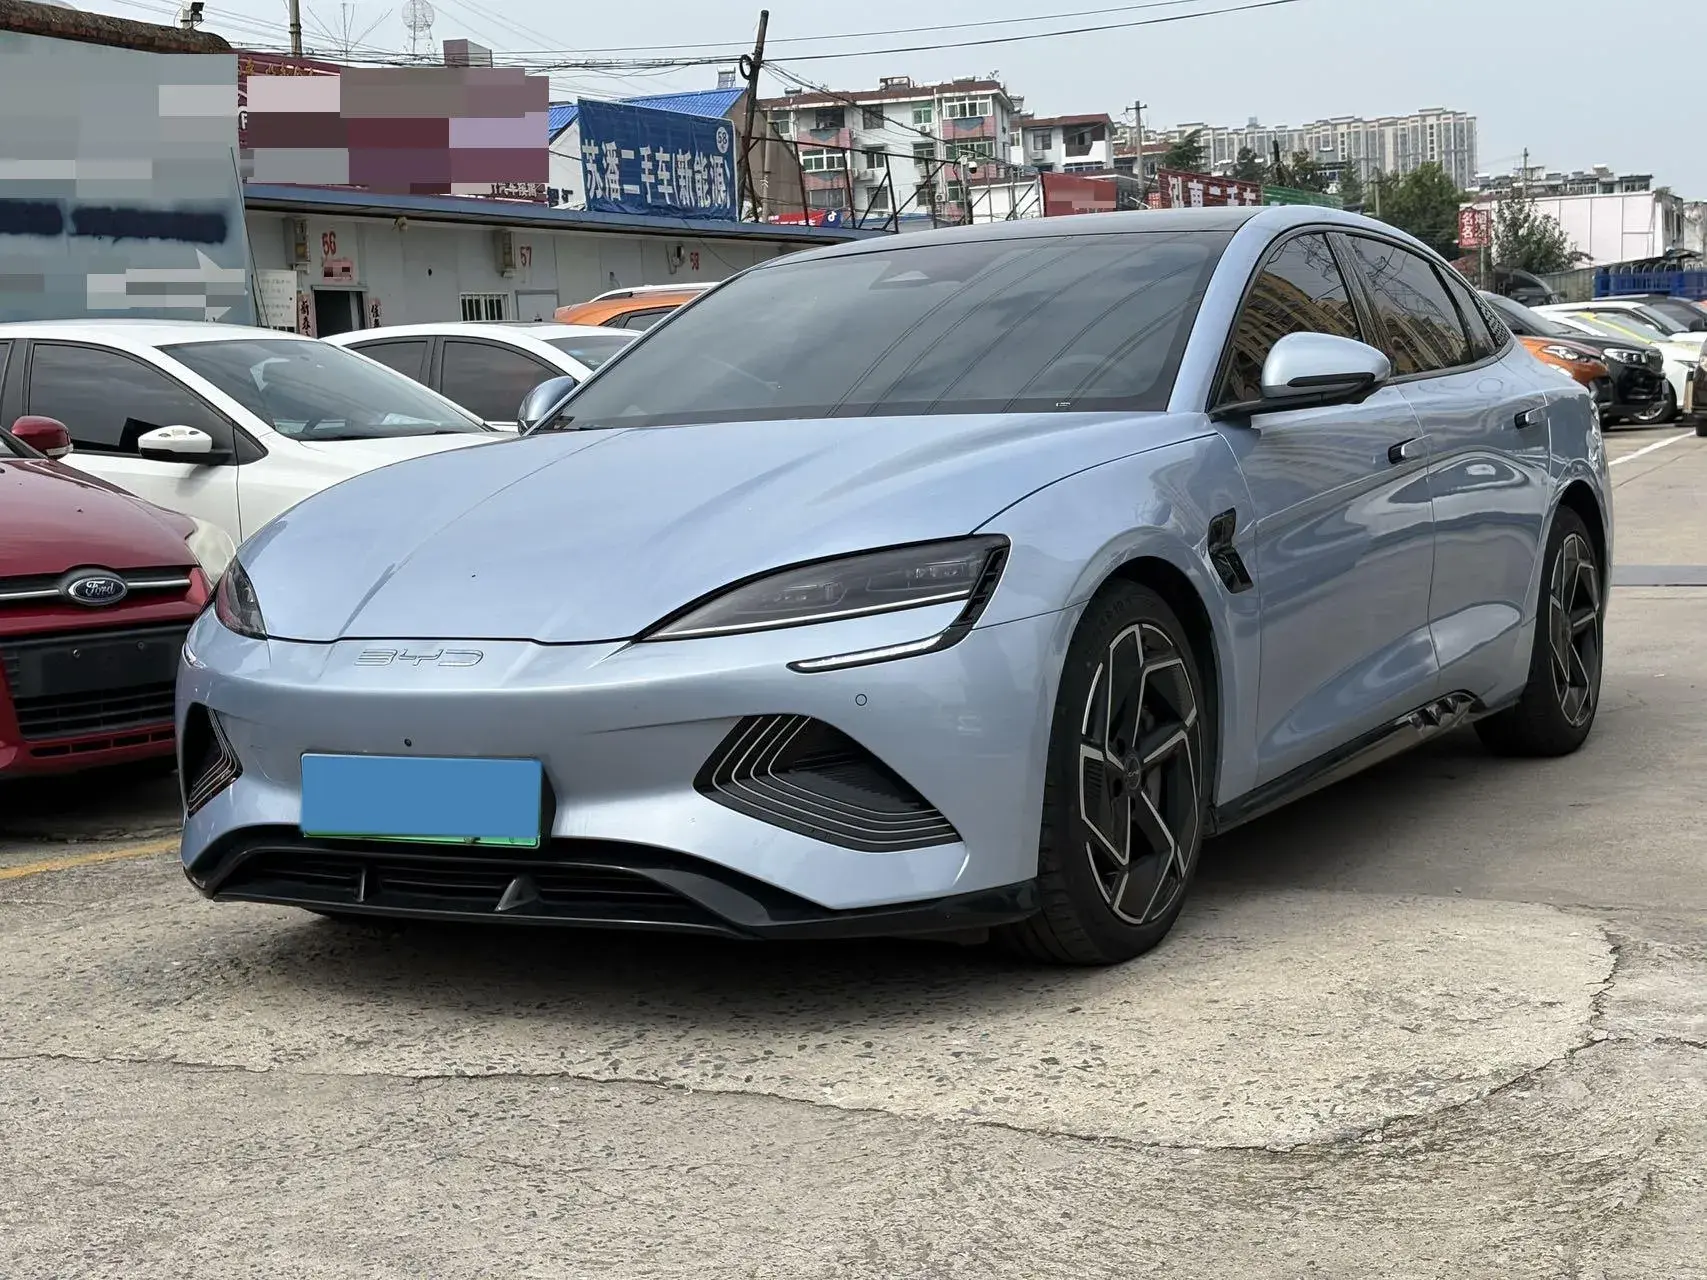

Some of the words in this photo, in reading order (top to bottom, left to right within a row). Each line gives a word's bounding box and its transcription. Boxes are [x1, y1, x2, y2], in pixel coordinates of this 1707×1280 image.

[718, 131, 727, 144] 58
[520, 246, 531, 267] 57
[86, 580, 114, 597] Ford
[354, 649, 484, 667] BYD
